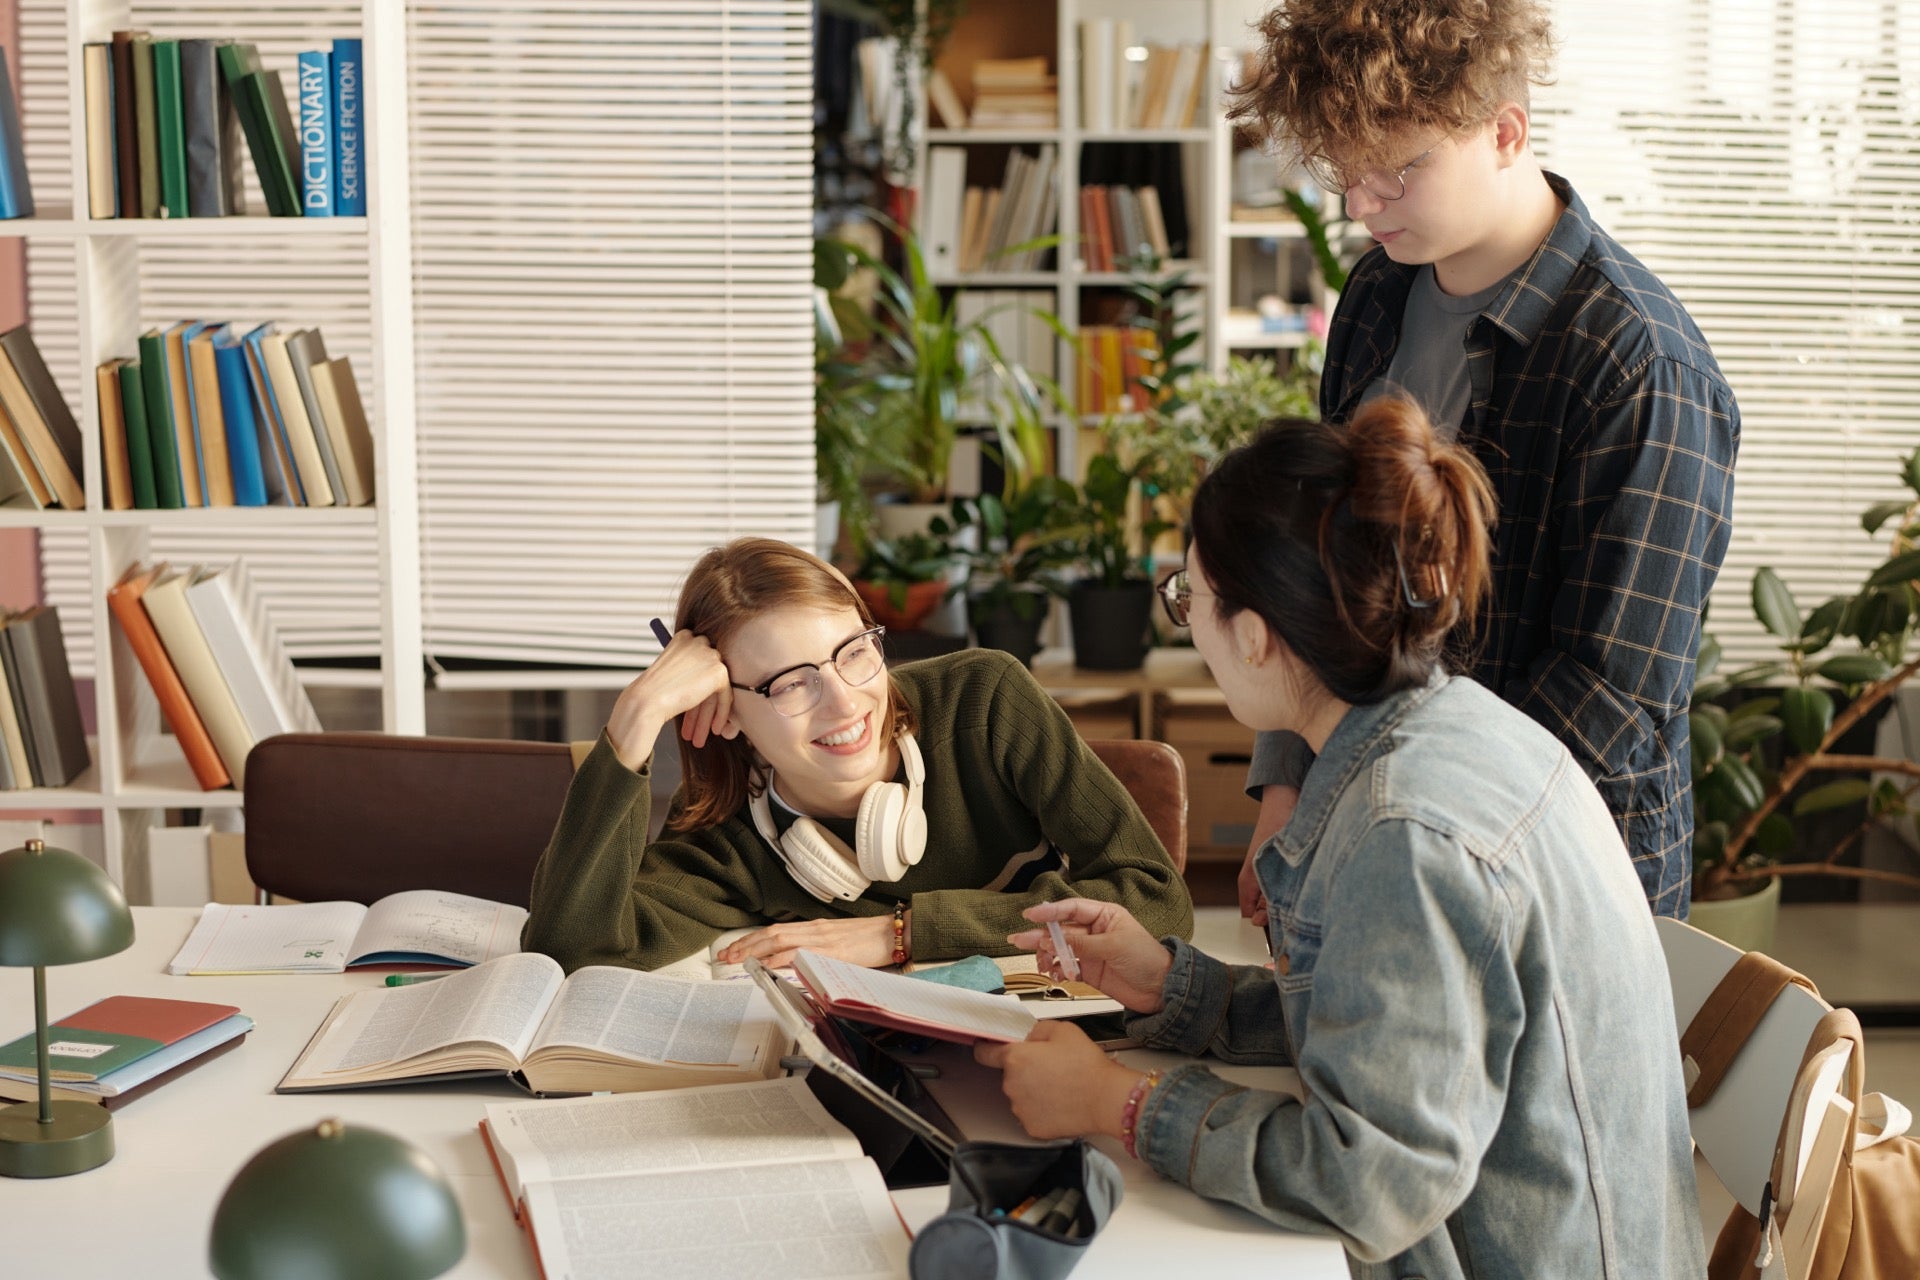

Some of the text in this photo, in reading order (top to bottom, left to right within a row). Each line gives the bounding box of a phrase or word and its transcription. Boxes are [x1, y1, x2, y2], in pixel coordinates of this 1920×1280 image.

[301, 62, 327, 208] DICTIONARY
[340, 61, 358, 199] SCIENCE FICTION
